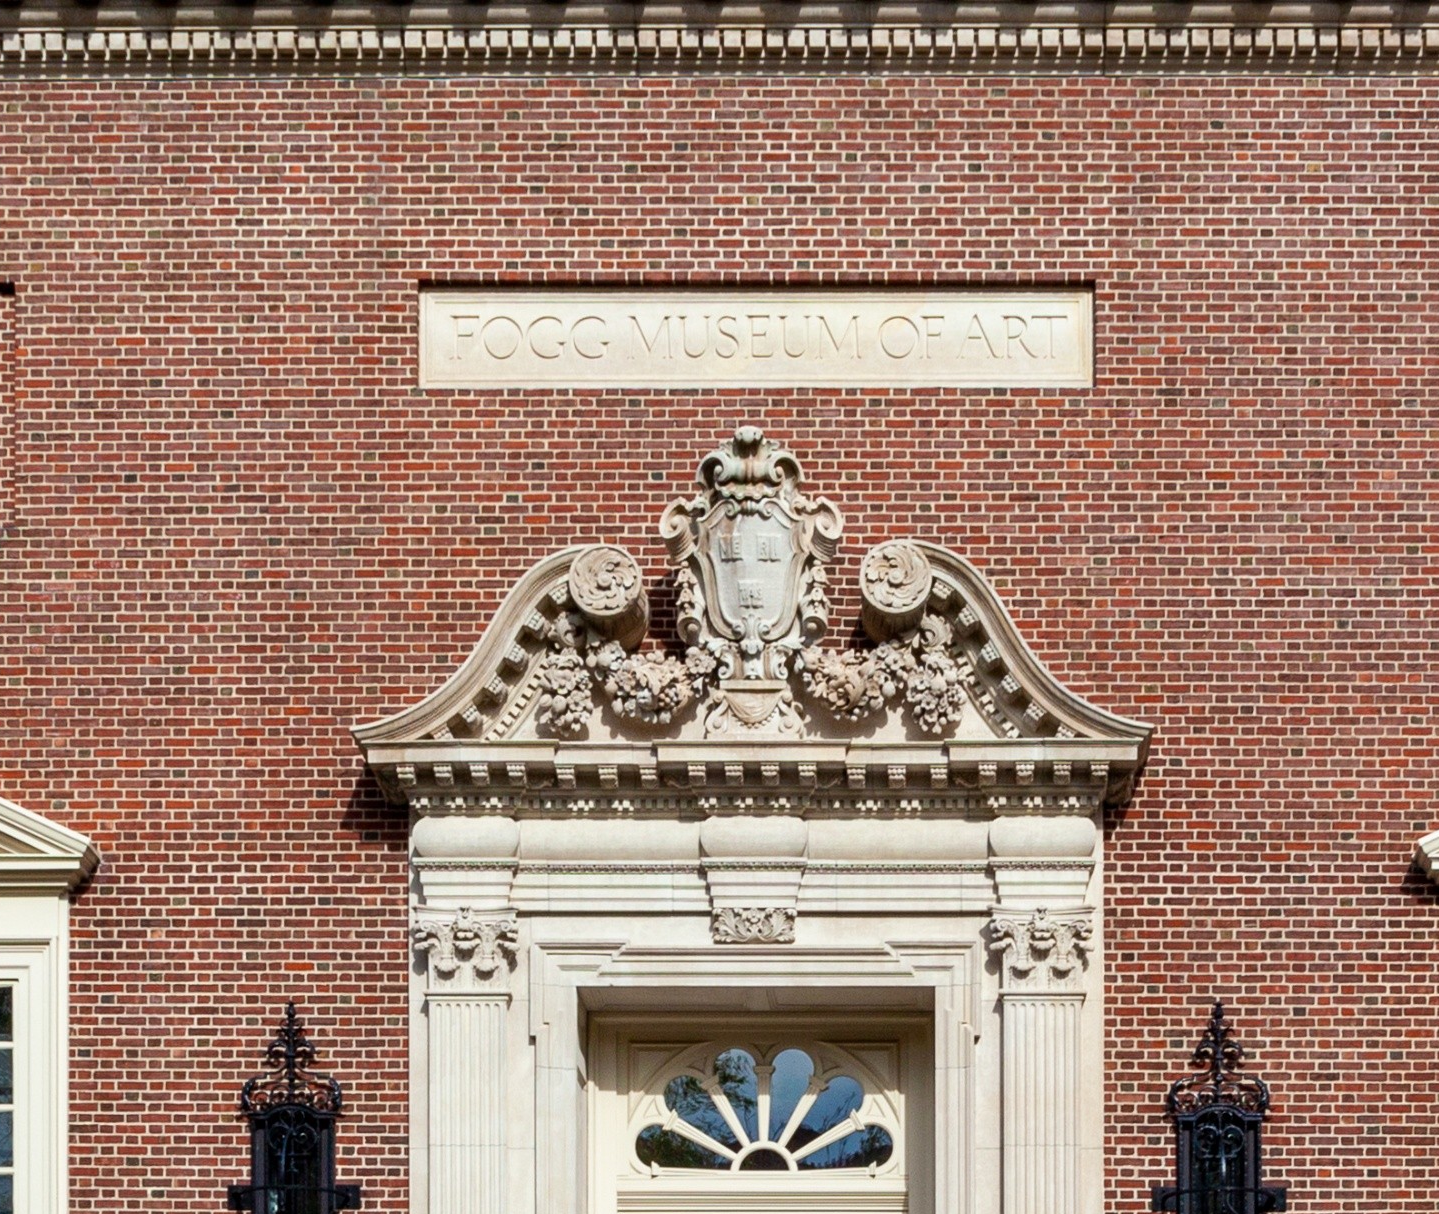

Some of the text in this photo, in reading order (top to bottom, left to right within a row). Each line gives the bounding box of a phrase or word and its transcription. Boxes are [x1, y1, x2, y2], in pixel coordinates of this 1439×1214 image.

[449, 312, 1069, 361] FOGG MUSEUM OF ART
